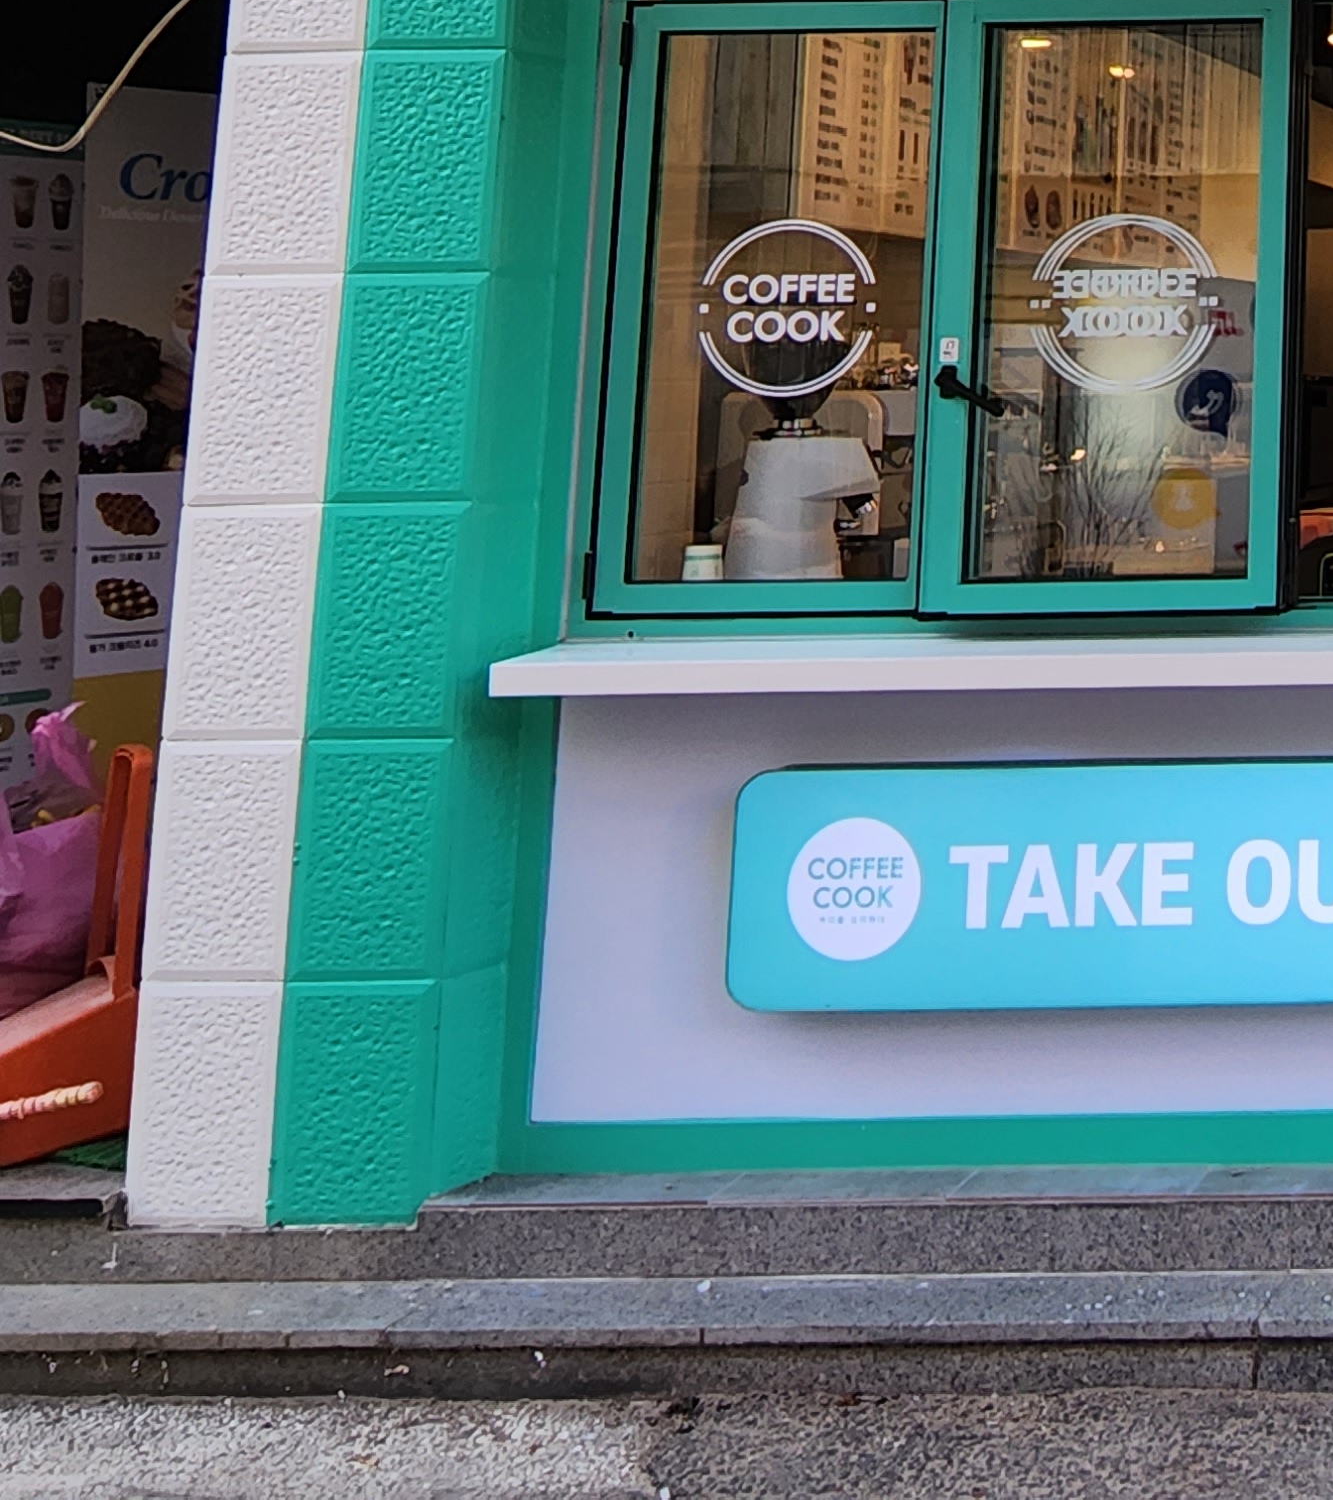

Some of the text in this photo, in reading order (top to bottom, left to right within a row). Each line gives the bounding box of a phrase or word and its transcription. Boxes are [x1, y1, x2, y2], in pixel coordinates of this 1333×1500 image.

[723, 274, 856, 304] COFFEE
[727, 310, 846, 343] COOK
[807, 857, 904, 880] COFFEE
[812, 885, 894, 909] COOK
[948, 841, 1195, 930] TAKE
